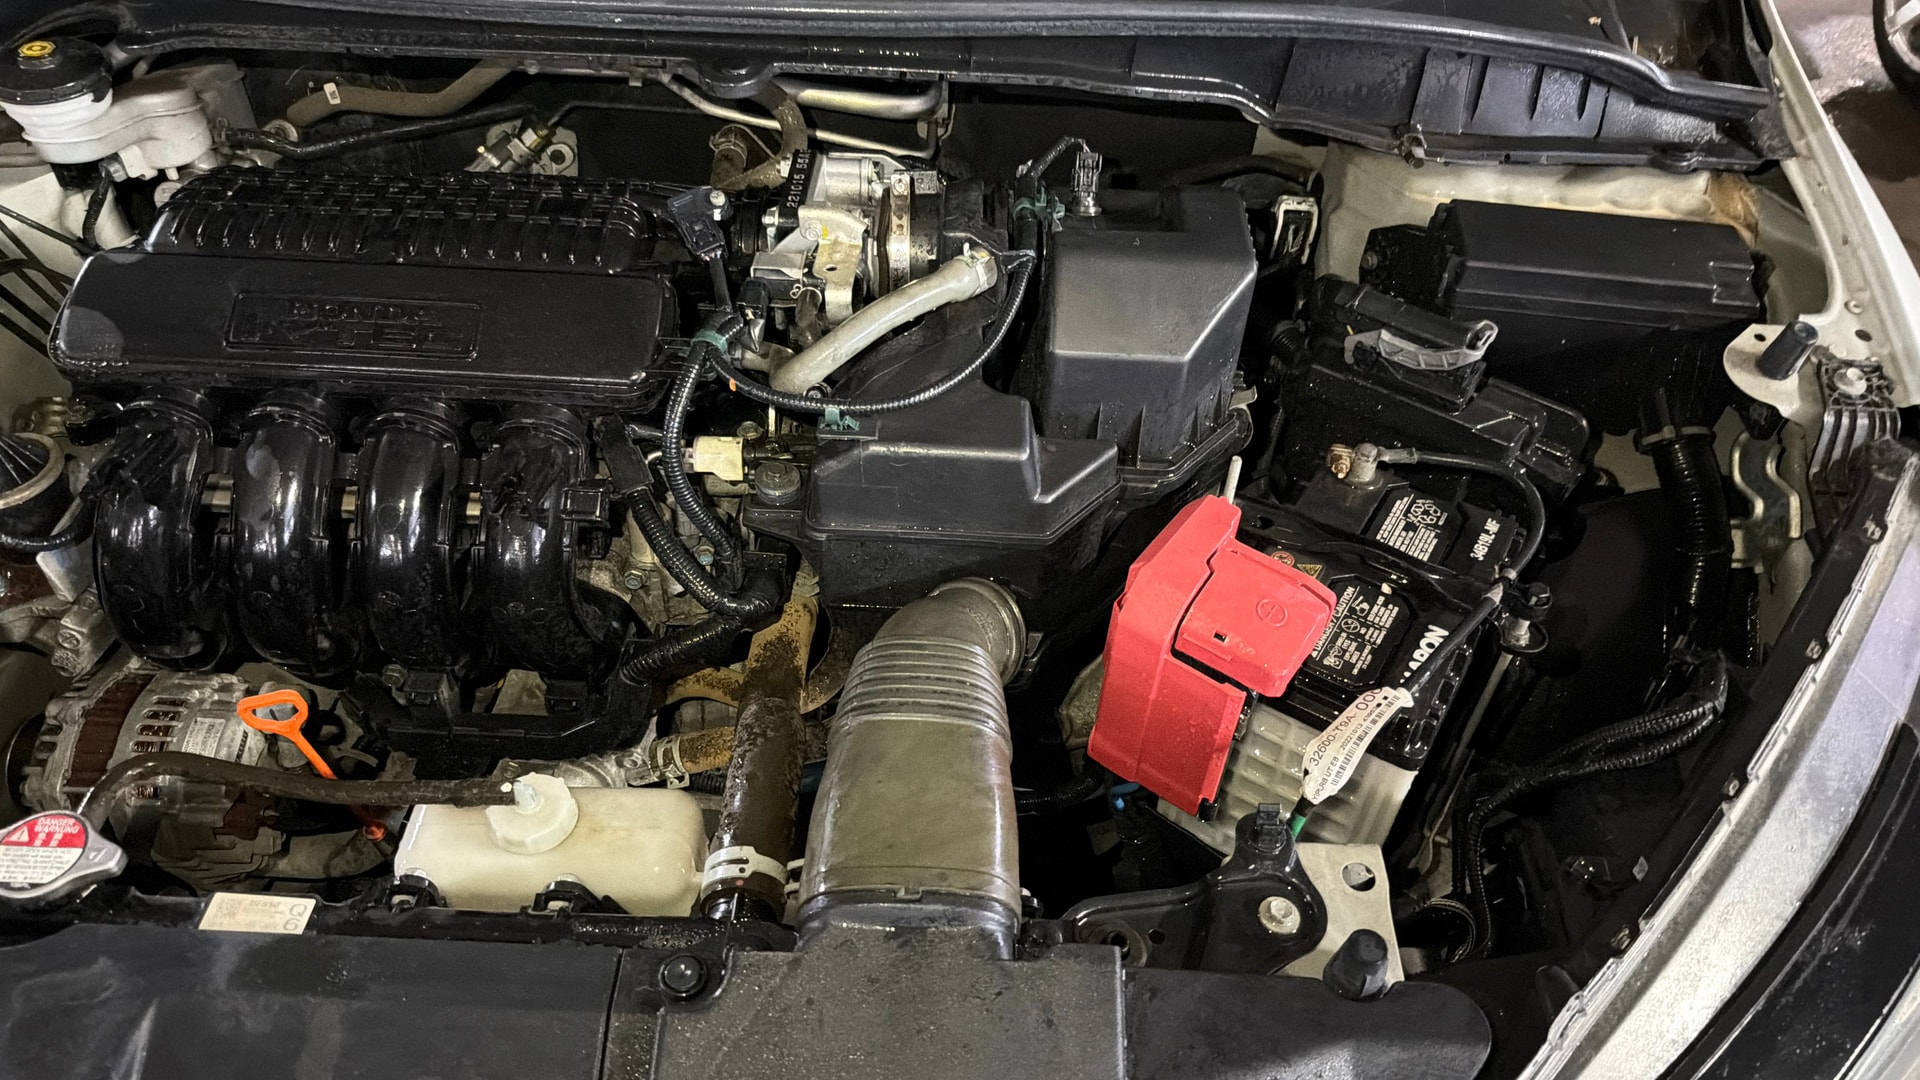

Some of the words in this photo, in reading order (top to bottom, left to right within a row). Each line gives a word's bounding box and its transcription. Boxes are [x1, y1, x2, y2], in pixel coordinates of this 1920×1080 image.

[1335, 586, 1356, 618] CAUTION
[37, 817, 76, 827] DANGER
[283, 917, 301, 932] 6
